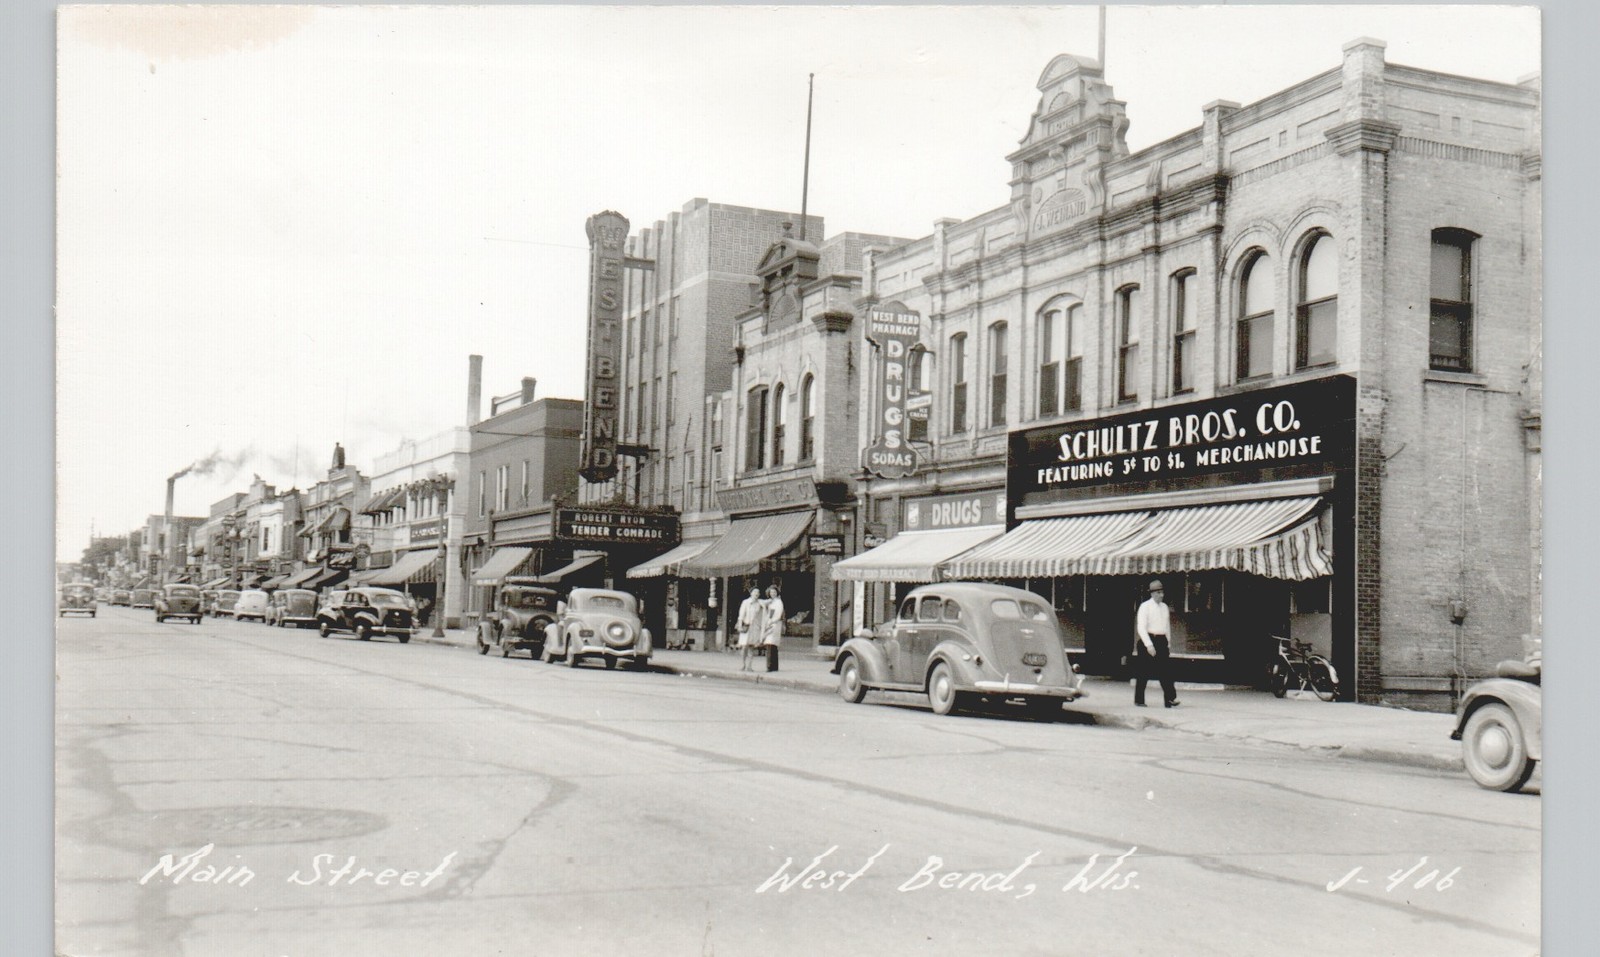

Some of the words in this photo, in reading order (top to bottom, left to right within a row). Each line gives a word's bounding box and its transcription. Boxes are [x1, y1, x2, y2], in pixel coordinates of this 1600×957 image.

[598, 225, 622, 342] WEST
[872, 310, 894, 322] WEST
[897, 313, 919, 325] BEND
[872, 322, 919, 336] PHARMACY
[884, 339, 904, 450] DRUGS
[593, 355, 616, 469] BEND
[1058, 420, 1160, 462] SCHULTZ
[1169, 408, 1246, 448] BROS.
[1256, 400, 1301, 436] CO.
[872, 452, 913, 466] SODAS
[1037, 460, 1114, 484] FEATURING
[1122, 457, 1137, 476] 5¢
[1142, 456, 1161, 473] TO
[1196, 435, 1322, 467] MERCHANDISE
[575, 513, 613, 523] ROBERT
[932, 499, 981, 526] DRUGS
[571, 525, 610, 536] TENDER
[616, 528, 662, 539] COMRADE
